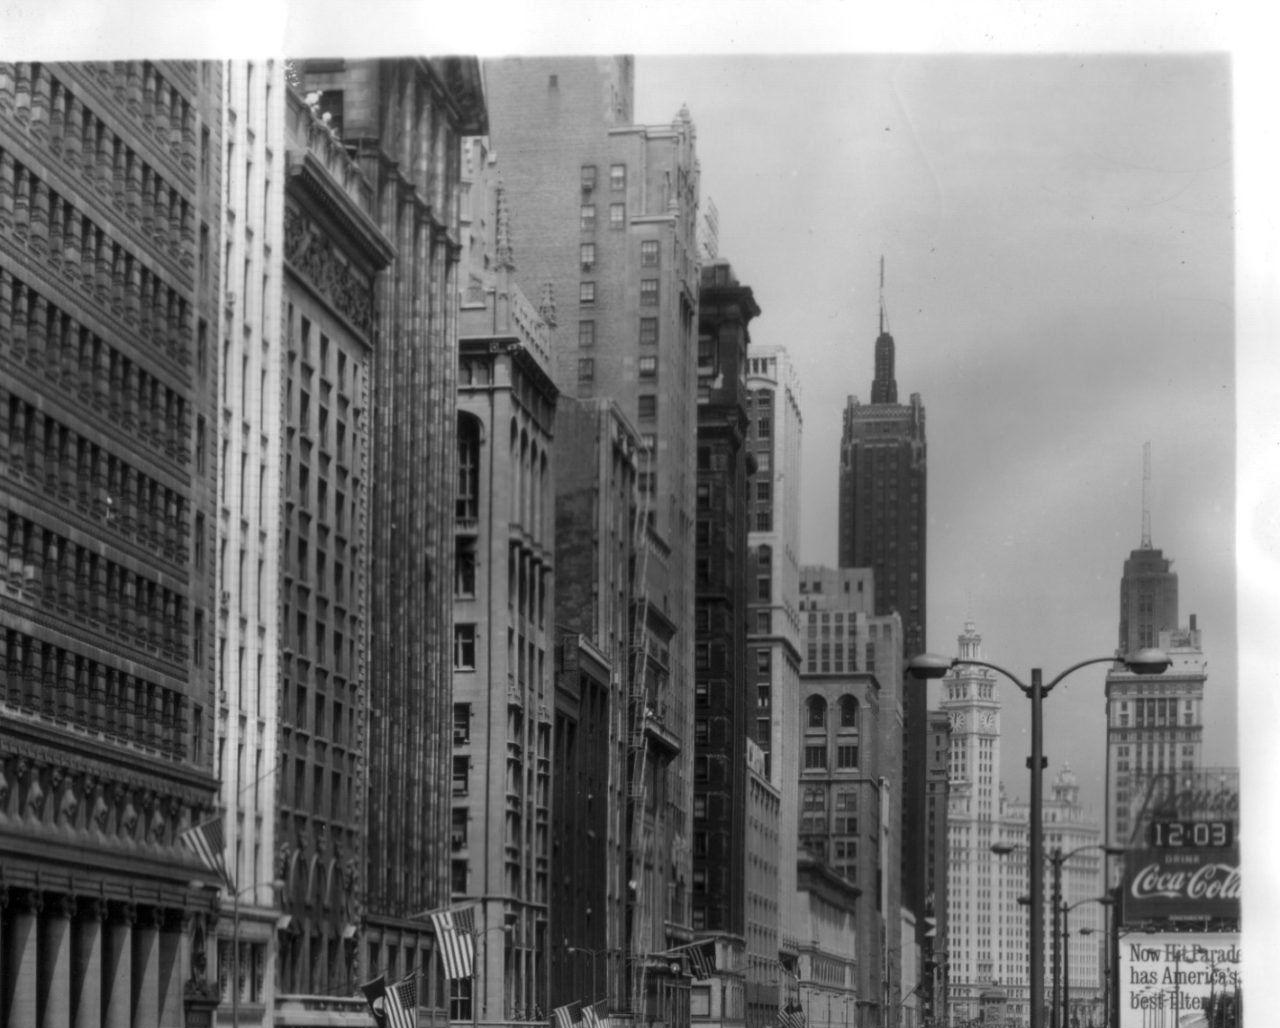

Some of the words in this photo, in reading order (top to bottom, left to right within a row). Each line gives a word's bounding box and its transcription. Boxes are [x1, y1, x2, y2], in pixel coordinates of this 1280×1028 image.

[1165, 855, 1200, 866] DRINK
[1129, 943, 1161, 962] Now
[1130, 966, 1158, 985] has
[1162, 966, 1238, 985] America's
[1130, 991, 1164, 1010] best
